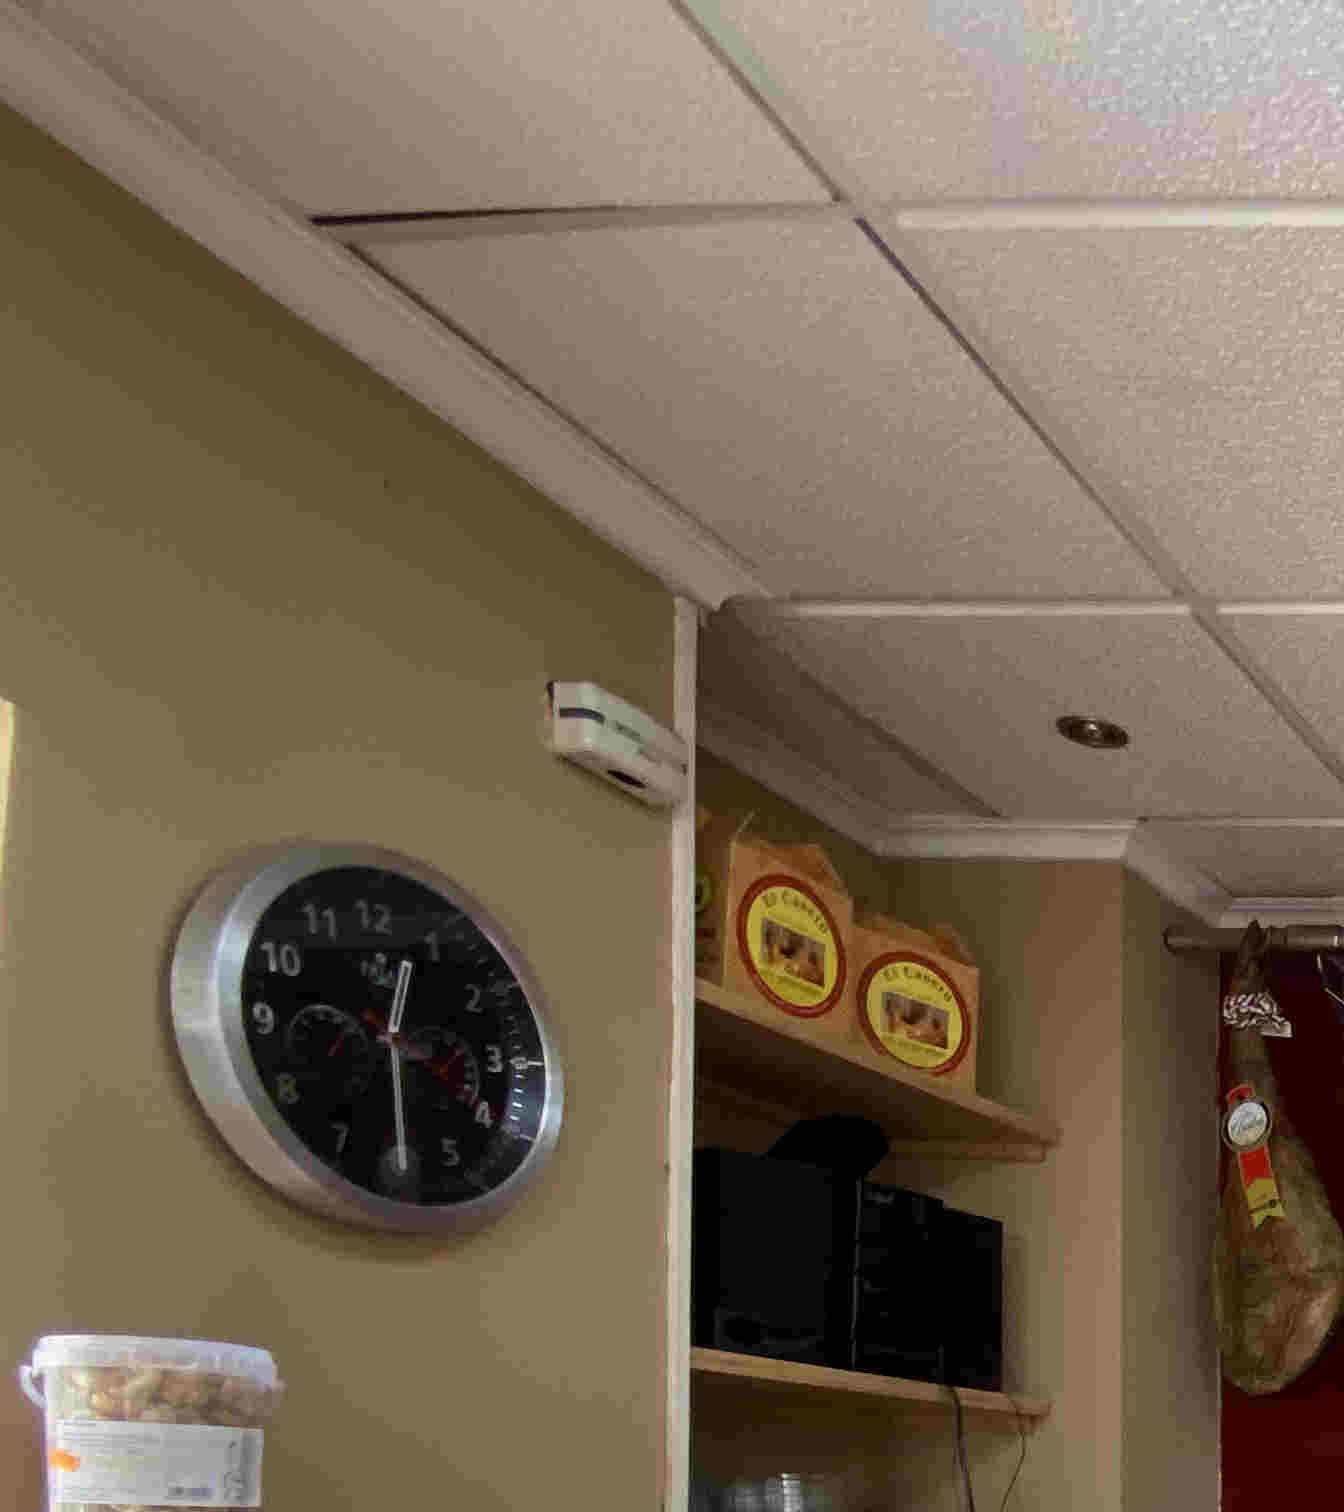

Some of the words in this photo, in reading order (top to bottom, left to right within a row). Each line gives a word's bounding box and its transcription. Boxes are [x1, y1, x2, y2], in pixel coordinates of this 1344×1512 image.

[302, 903, 338, 944] 11
[355, 900, 393, 936] 12
[259, 941, 301, 977] 10
[463, 983, 483, 1014] 2
[252, 1002, 275, 1035] 9
[485, 1043, 503, 1073] 3
[474, 1101, 494, 1128] 4
[332, 1121, 349, 1153] 7
[440, 1137, 461, 1167] 5
